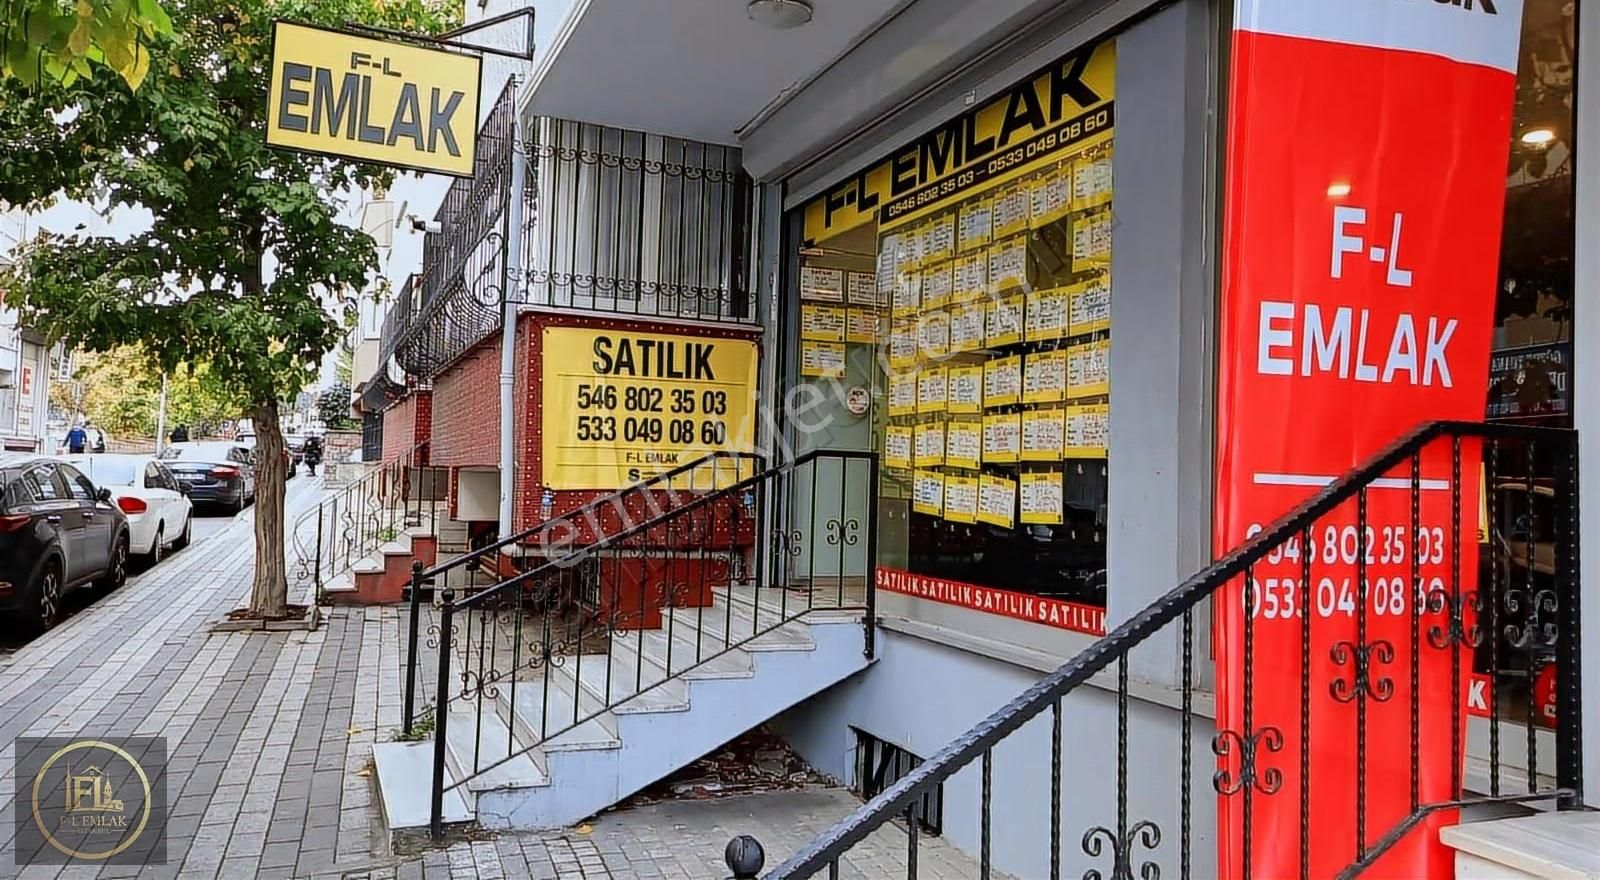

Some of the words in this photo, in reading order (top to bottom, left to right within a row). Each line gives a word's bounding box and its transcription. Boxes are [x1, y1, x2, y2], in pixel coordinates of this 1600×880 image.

[351, 51, 402, 77] F-L
[278, 61, 465, 157] EMLAK
[892, 45, 1102, 197] EMLAK
[888, 195, 915, 216] 0546
[940, 181, 956, 194] 35
[957, 171, 974, 187] 03
[988, 149, 1024, 174] 0533
[1026, 133, 1056, 157] 049
[1060, 122, 1080, 142] 08
[1084, 110, 1107, 132] 60
[1330, 205, 1412, 287] F-L
[593, 335, 715, 380] SATILIK
[1257, 300, 1459, 388] EMLAK
[577, 384, 617, 410] 546
[624, 386, 663, 412] 802
[670, 389, 695, 414] 35
[702, 391, 727, 415] 03
[577, 416, 617, 441] 533
[624, 417, 662, 443] 049
[670, 419, 694, 444] 08
[701, 421, 726, 445] 60
[626, 452, 642, 463] F-L
[645, 452, 678, 464] EMLAK
[1380, 526, 1405, 565] 35
[1418, 526, 1444, 565] 03
[876, 570, 919, 594] SATILIK
[921, 580, 971, 604] SATILIK
[975, 590, 1034, 617] SATILIK
[1374, 576, 1405, 616] 08
